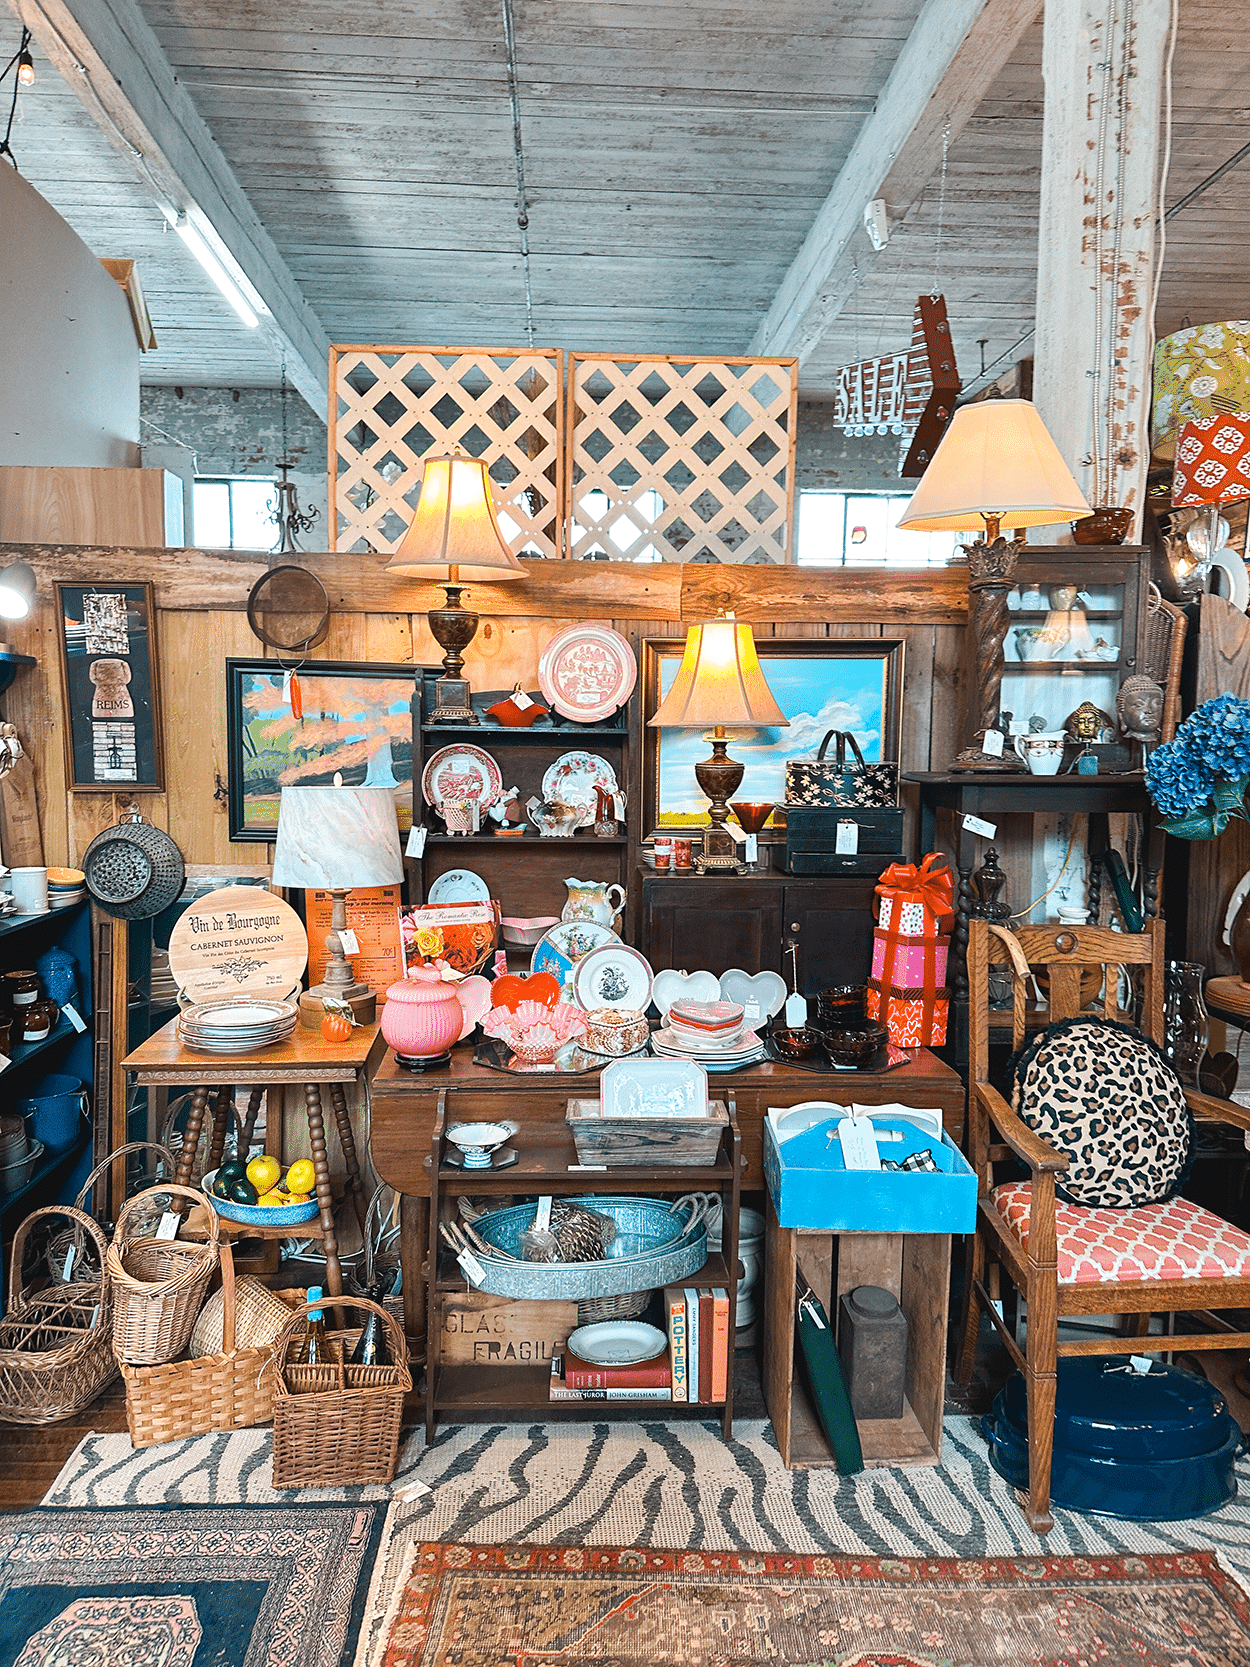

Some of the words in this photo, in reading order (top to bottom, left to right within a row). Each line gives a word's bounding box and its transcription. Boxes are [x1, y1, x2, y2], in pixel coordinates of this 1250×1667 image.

[838, 354, 909, 424] SALE
[96, 700, 130, 710] REIMS
[189, 916, 209, 934] Vin
[212, 917, 224, 931] de
[226, 912, 281, 930] Bourgogne
[418, 912, 434, 921] The
[190, 940, 233, 951] CABERNET
[234, 935, 284, 947] SAUVIGNON
[445, 1313, 516, 1333] GLAS
[673, 1316, 685, 1384] POTTERY
[583, 1391, 605, 1399] JUROR
